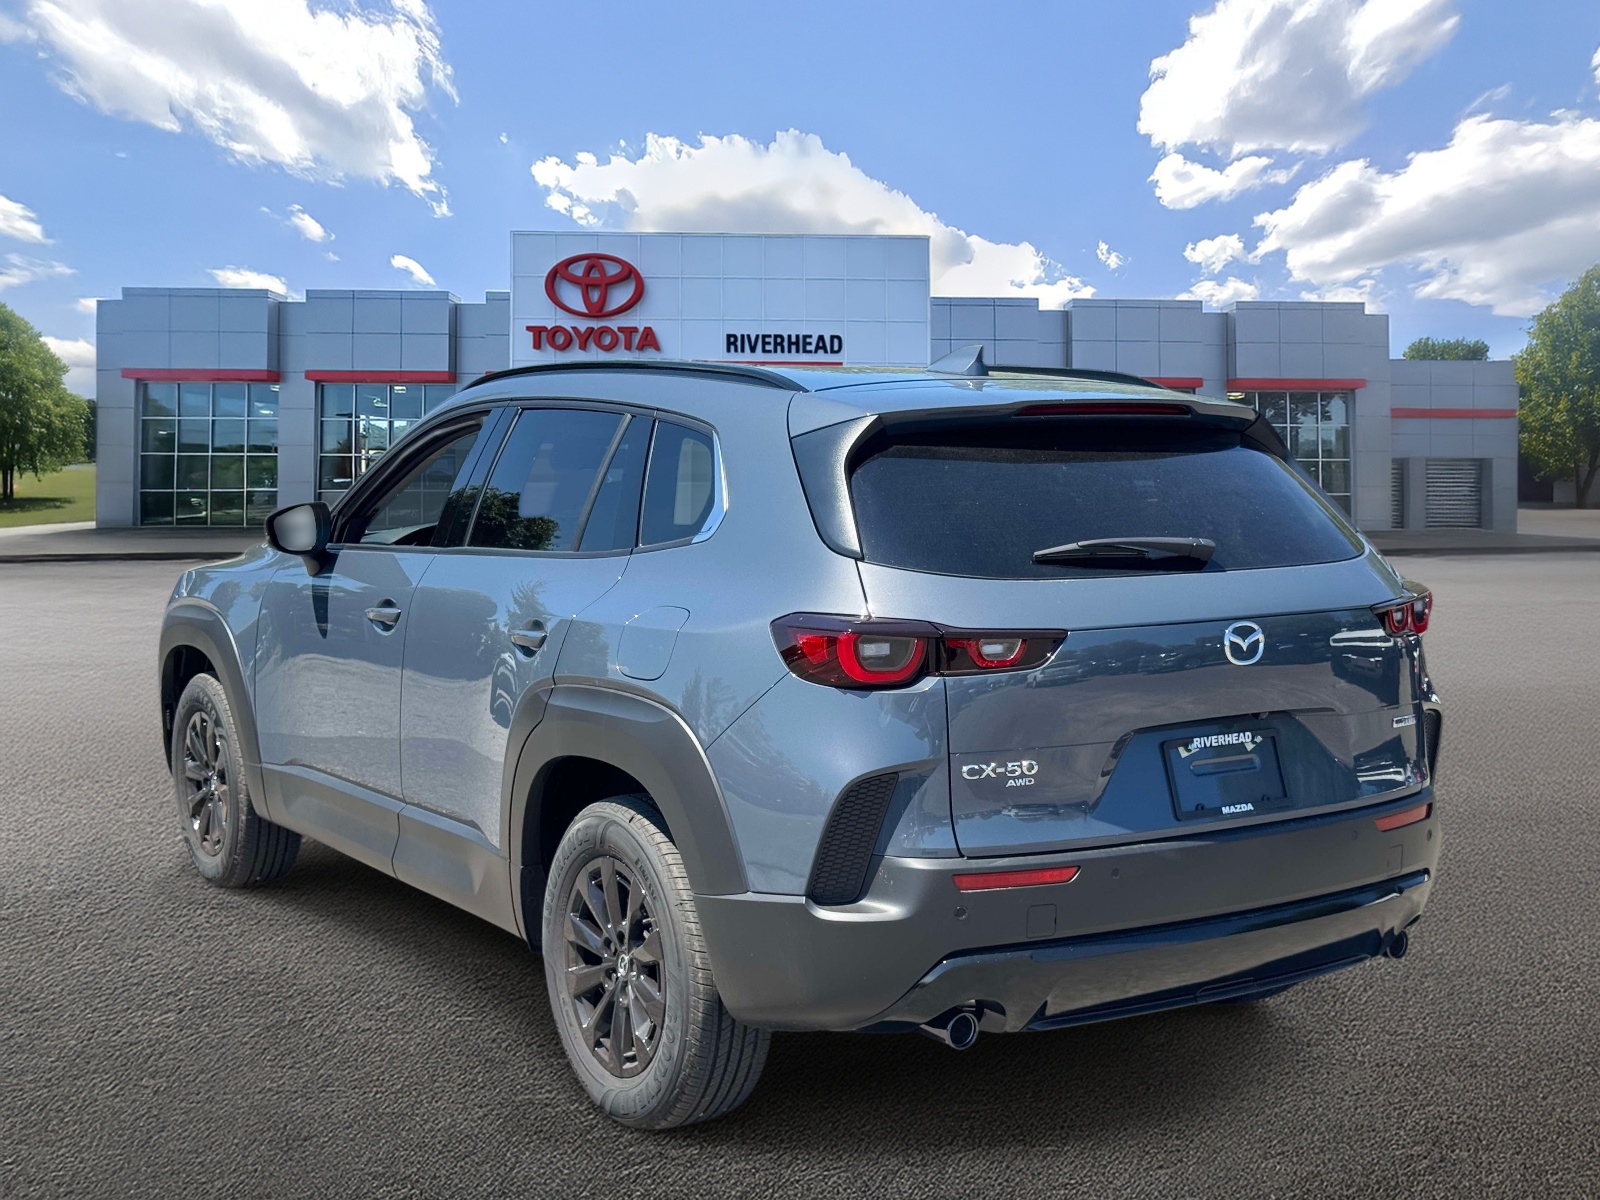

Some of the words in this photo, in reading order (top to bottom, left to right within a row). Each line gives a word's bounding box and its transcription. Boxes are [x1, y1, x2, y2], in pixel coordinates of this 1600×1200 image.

[526, 325, 661, 352] TOYOTA
[725, 333, 843, 355] RIVERHEAD
[1193, 731, 1252, 749] RIVERHEAD
[961, 760, 1039, 780] CX-50
[1005, 777, 1035, 788] AWD
[1221, 802, 1254, 815] MAZDA
